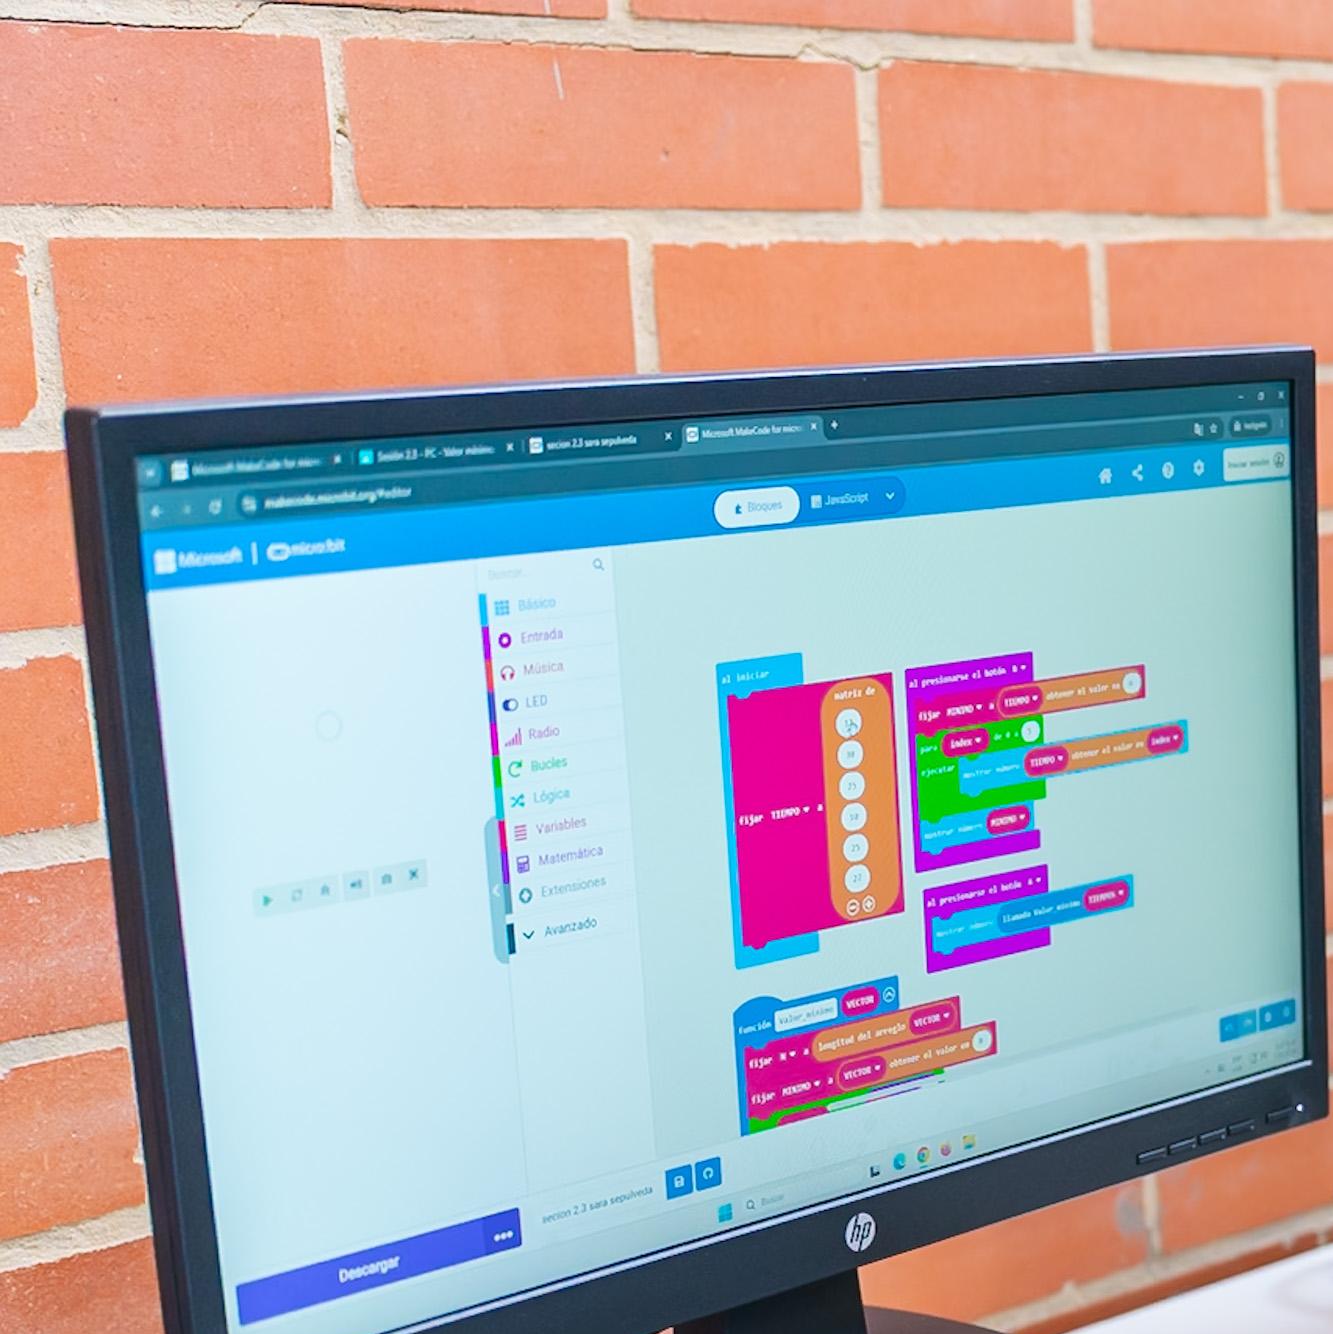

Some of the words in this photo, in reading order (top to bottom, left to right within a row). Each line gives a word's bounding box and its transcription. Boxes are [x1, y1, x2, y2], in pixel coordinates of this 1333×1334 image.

[701, 427, 734, 438] Microsoft
[734, 426, 770, 436] MakeCode
[771, 425, 781, 433] for
[747, 500, 782, 514] Bloques
[825, 492, 869, 507] JavaScript
[178, 546, 243, 568] Microsoft
[518, 597, 556, 612] Básico
[520, 628, 564, 644] Entrada
[523, 662, 564, 674] Música
[908, 678, 920, 688] al
[920, 669, 970, 689] presionarse
[971, 669, 982, 682] el
[983, 664, 1007, 680] botón
[721, 674, 730, 684] al
[736, 671, 769, 681] iniciar
[525, 694, 547, 708] LED
[832, 686, 863, 703] matriz
[864, 683, 876, 695] de
[917, 707, 942, 724] fijar
[528, 726, 560, 739] Radio
[531, 757, 568, 772] Bucles
[920, 761, 956, 778] ejecutar
[533, 789, 570, 804] Lógica
[737, 814, 763, 827] fijar
[770, 804, 798, 825] TIEMPO
[536, 817, 586, 834] Variables
[538, 846, 603, 865] Matemática
[541, 877, 606, 897] Extensiones
[926, 896, 937, 911] al
[937, 886, 985, 908] presionarse
[987, 883, 998, 897] el
[544, 917, 597, 936] Avanzado
[737, 1020, 772, 1034] función
[845, 991, 875, 1013] VECTOR
[747, 1052, 774, 1073] fijar
[818, 1032, 855, 1054] longitud
[856, 1028, 872, 1046] del
[875, 1020, 906, 1039] arreglo
[913, 1011, 941, 1031] VECTOR
[750, 1088, 776, 1108] fijar
[781, 1078, 813, 1100] MINIMO
[843, 1063, 872, 1083] VECTOR
[889, 1055, 920, 1071] obtener
[923, 1047, 933, 1061] el
[935, 1043, 957, 1056] valor
[589, 1199, 607, 1212] sara
[607, 1184, 653, 1205] sepulveda
[846, 1212, 876, 1252] hp
[339, 1255, 400, 1283] Descargar
